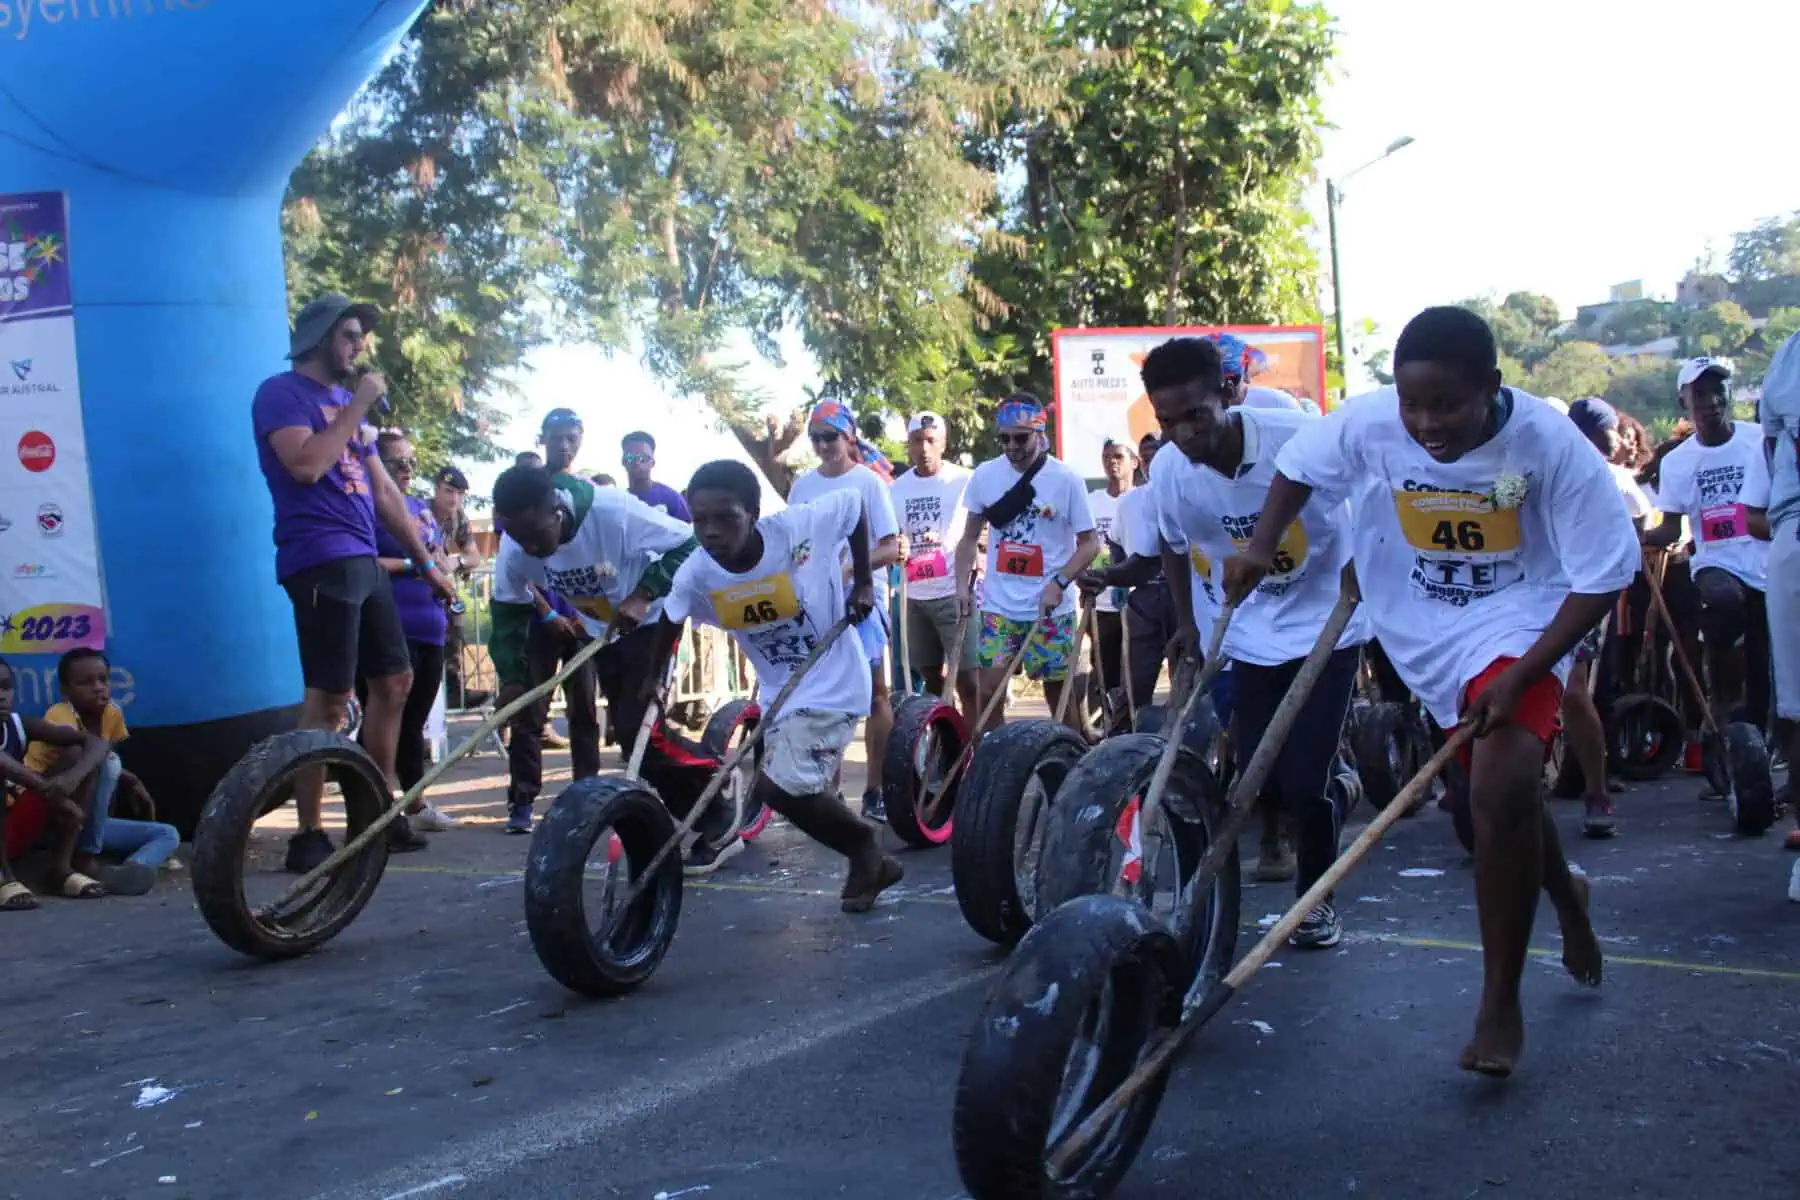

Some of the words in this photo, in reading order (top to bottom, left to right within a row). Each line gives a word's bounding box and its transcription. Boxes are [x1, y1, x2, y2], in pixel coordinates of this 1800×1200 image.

[907, 512, 941, 521] MAY
[1432, 521, 1485, 551] 46
[1008, 557, 1028, 573] 47
[744, 601, 778, 624] 46
[20, 615, 91, 640] 2023
